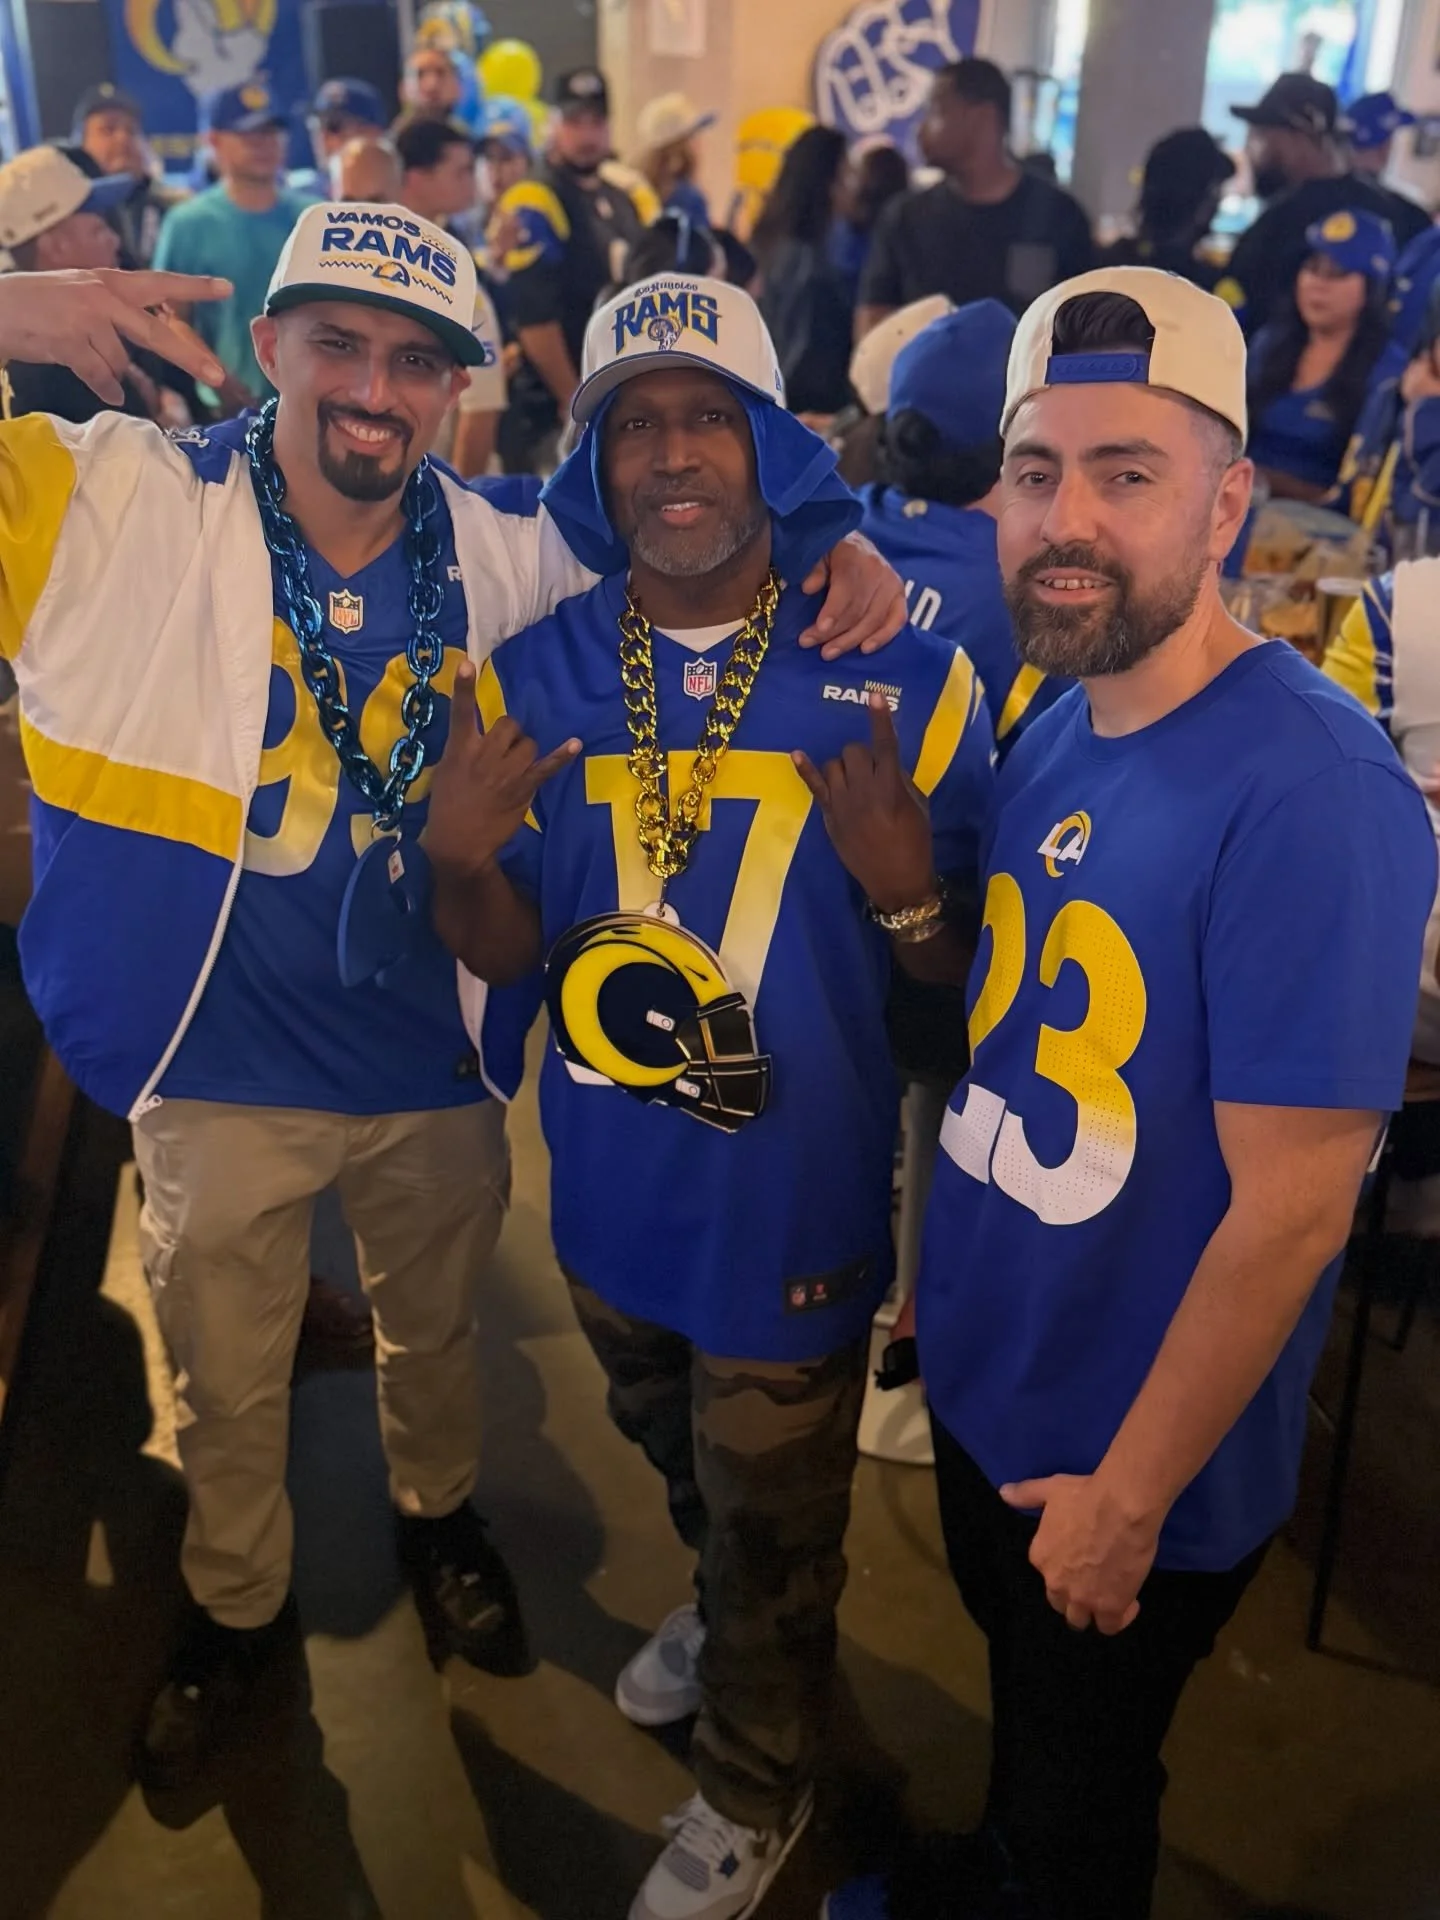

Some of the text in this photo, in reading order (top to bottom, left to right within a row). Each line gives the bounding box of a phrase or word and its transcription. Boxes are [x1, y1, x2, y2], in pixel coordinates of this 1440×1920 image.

[327, 211, 421, 238] VAMOS
[322, 227, 457, 287] RAMS
[611, 291, 723, 356] RAMS
[688, 675, 712, 691] NFL
[1037, 811, 1091, 872] LA
[585, 749, 814, 1020] 17
[939, 872, 1147, 1225] 23
